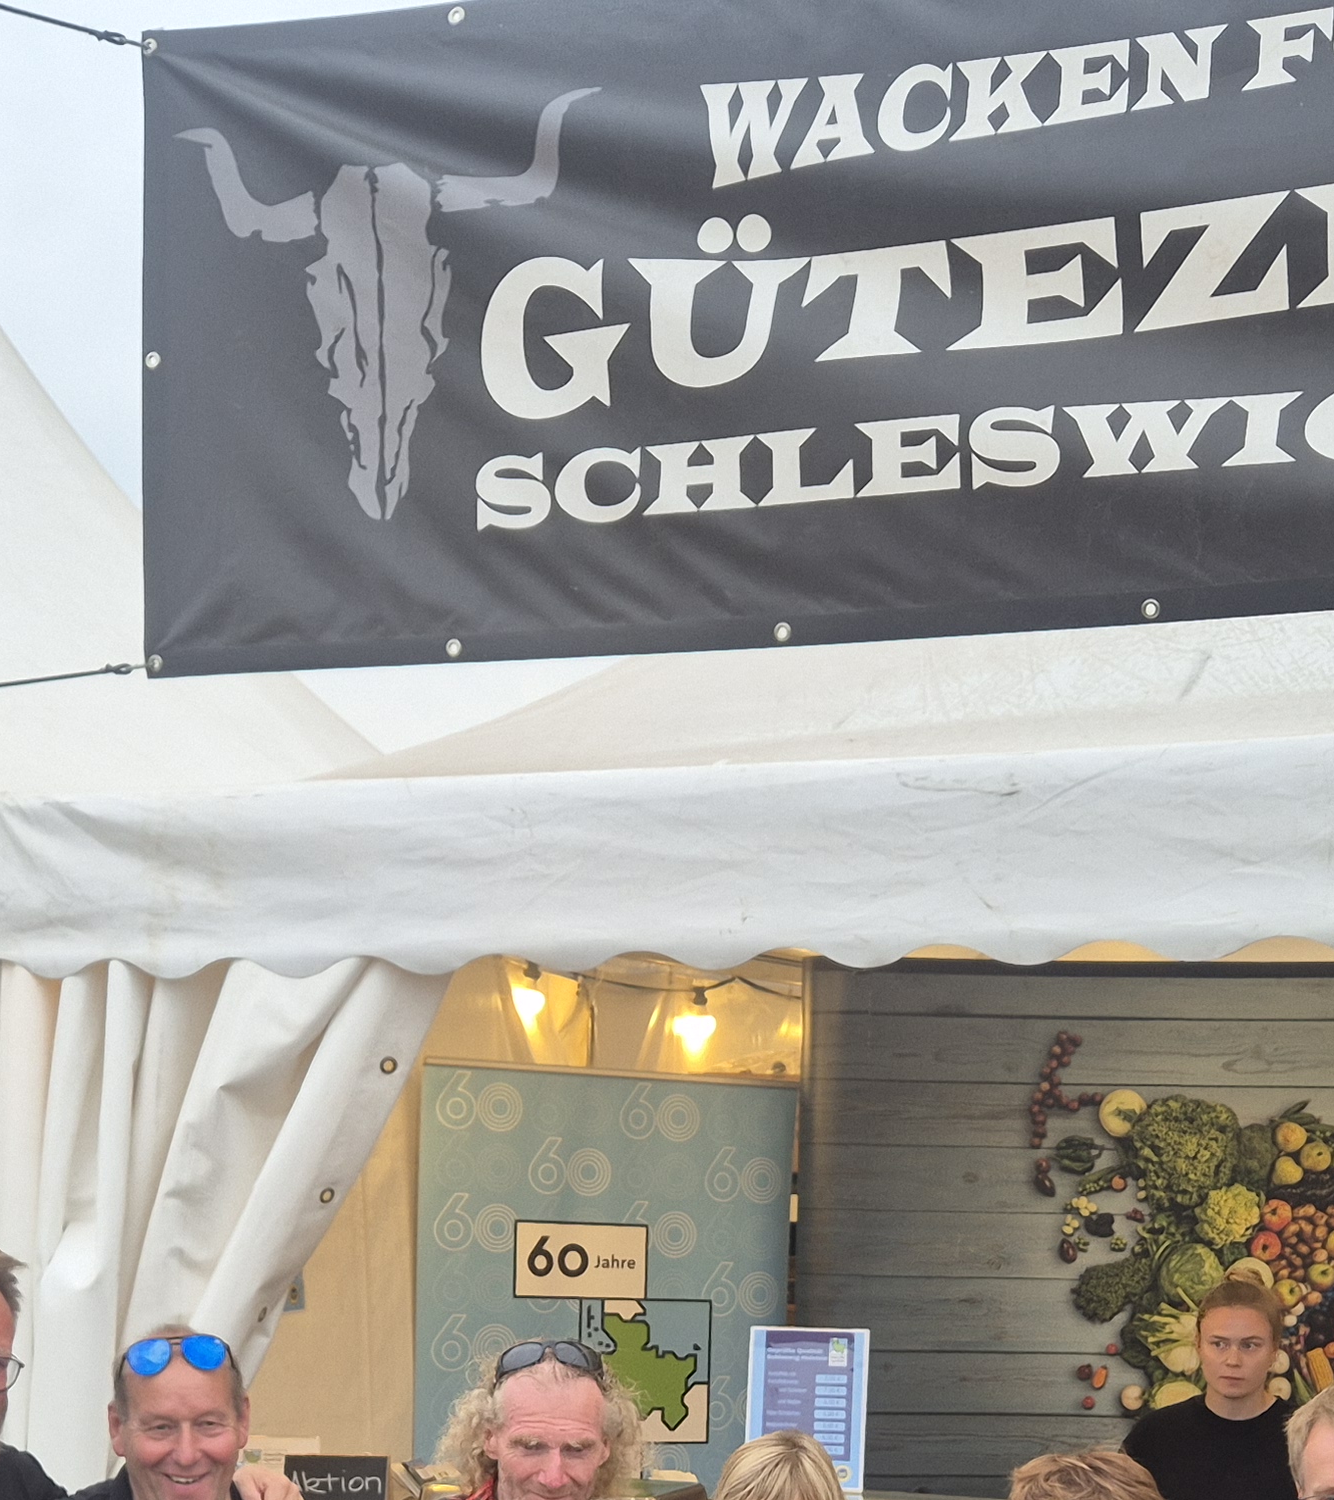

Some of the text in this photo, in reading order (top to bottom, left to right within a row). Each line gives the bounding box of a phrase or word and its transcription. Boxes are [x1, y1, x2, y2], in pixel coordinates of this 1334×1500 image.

[700, 23, 1231, 189] WACKEN
[436, 1070, 523, 1131] 60
[620, 1082, 700, 1141] 60
[528, 1137, 612, 1196] 60
[705, 1146, 782, 1203] 60
[434, 1192, 516, 1252] 60
[527, 1236, 637, 1278] 60 Jahre
[703, 1262, 780, 1317] 60
